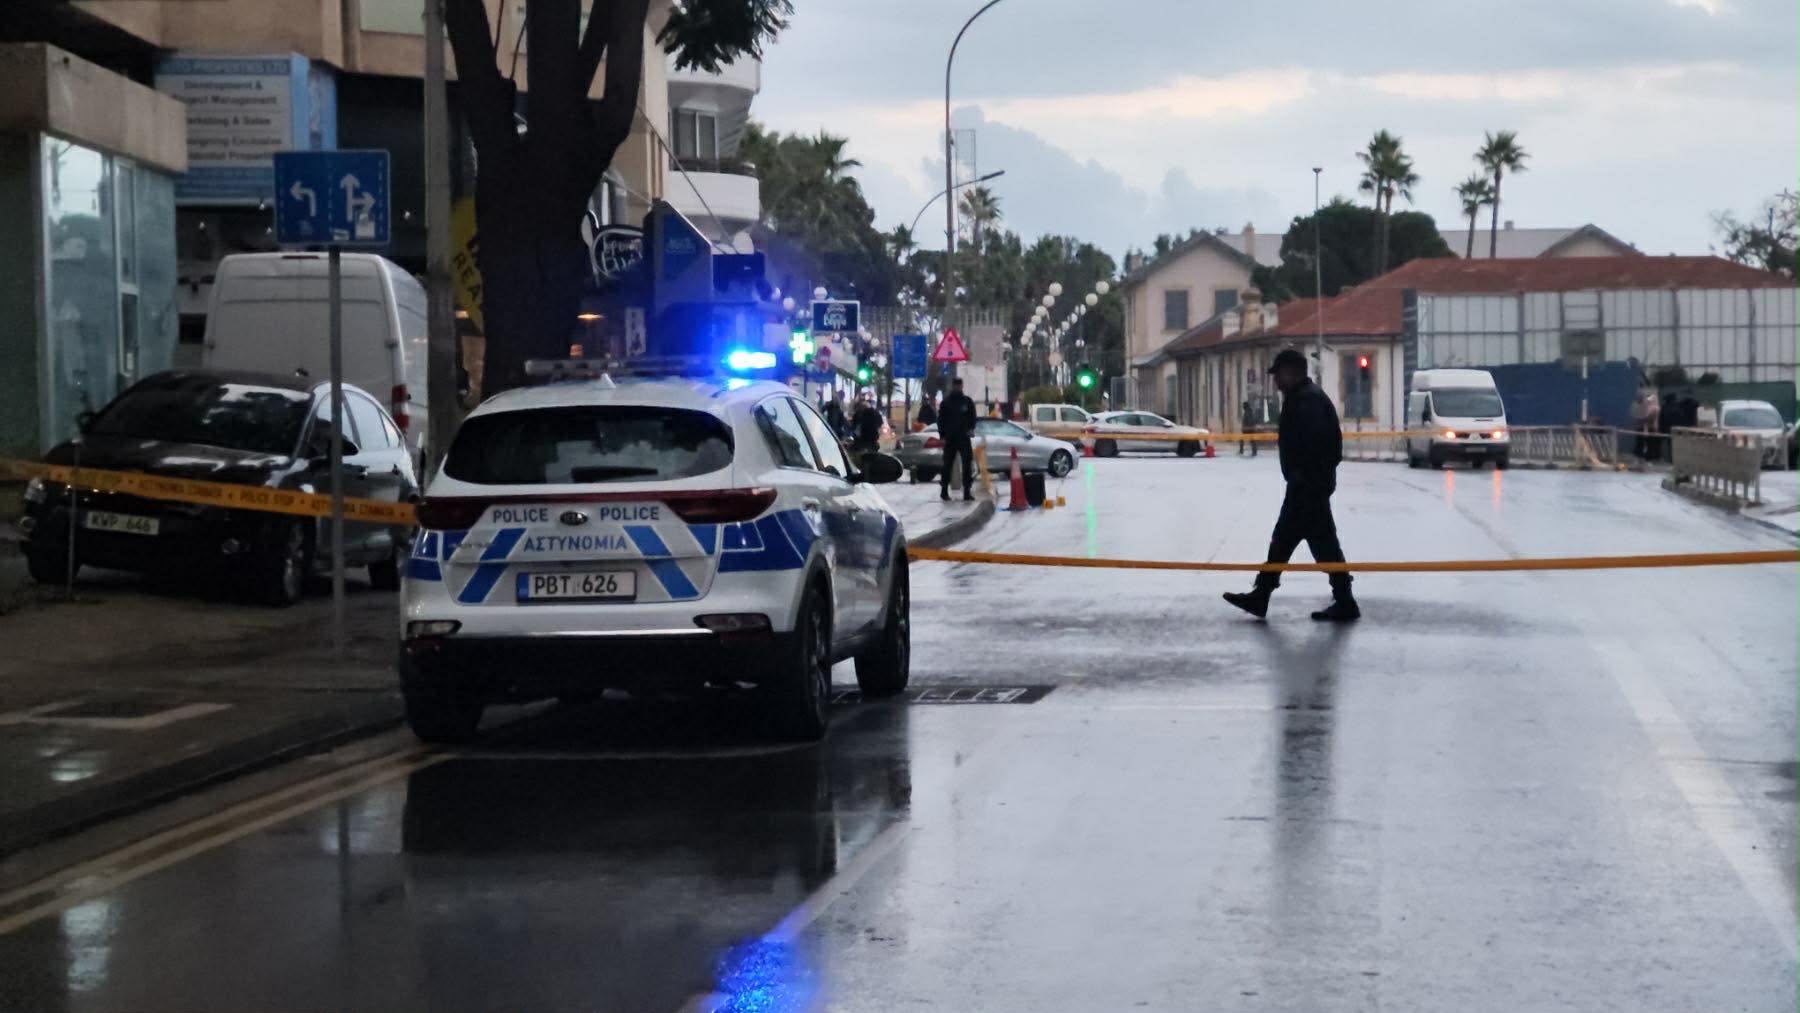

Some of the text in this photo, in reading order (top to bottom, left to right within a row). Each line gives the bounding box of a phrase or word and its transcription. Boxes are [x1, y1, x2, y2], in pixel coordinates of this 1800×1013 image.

[184, 80, 263, 90] Development &
[211, 96, 277, 106] Management
[186, 116, 271, 128] arketing & Sales
[492, 508, 549, 523] POLICE
[600, 506, 660, 521] POLICE
[523, 535, 628, 552] ΑΣΤΥΝΟΜΙΑ
[534, 574, 618, 595] PBT 626
